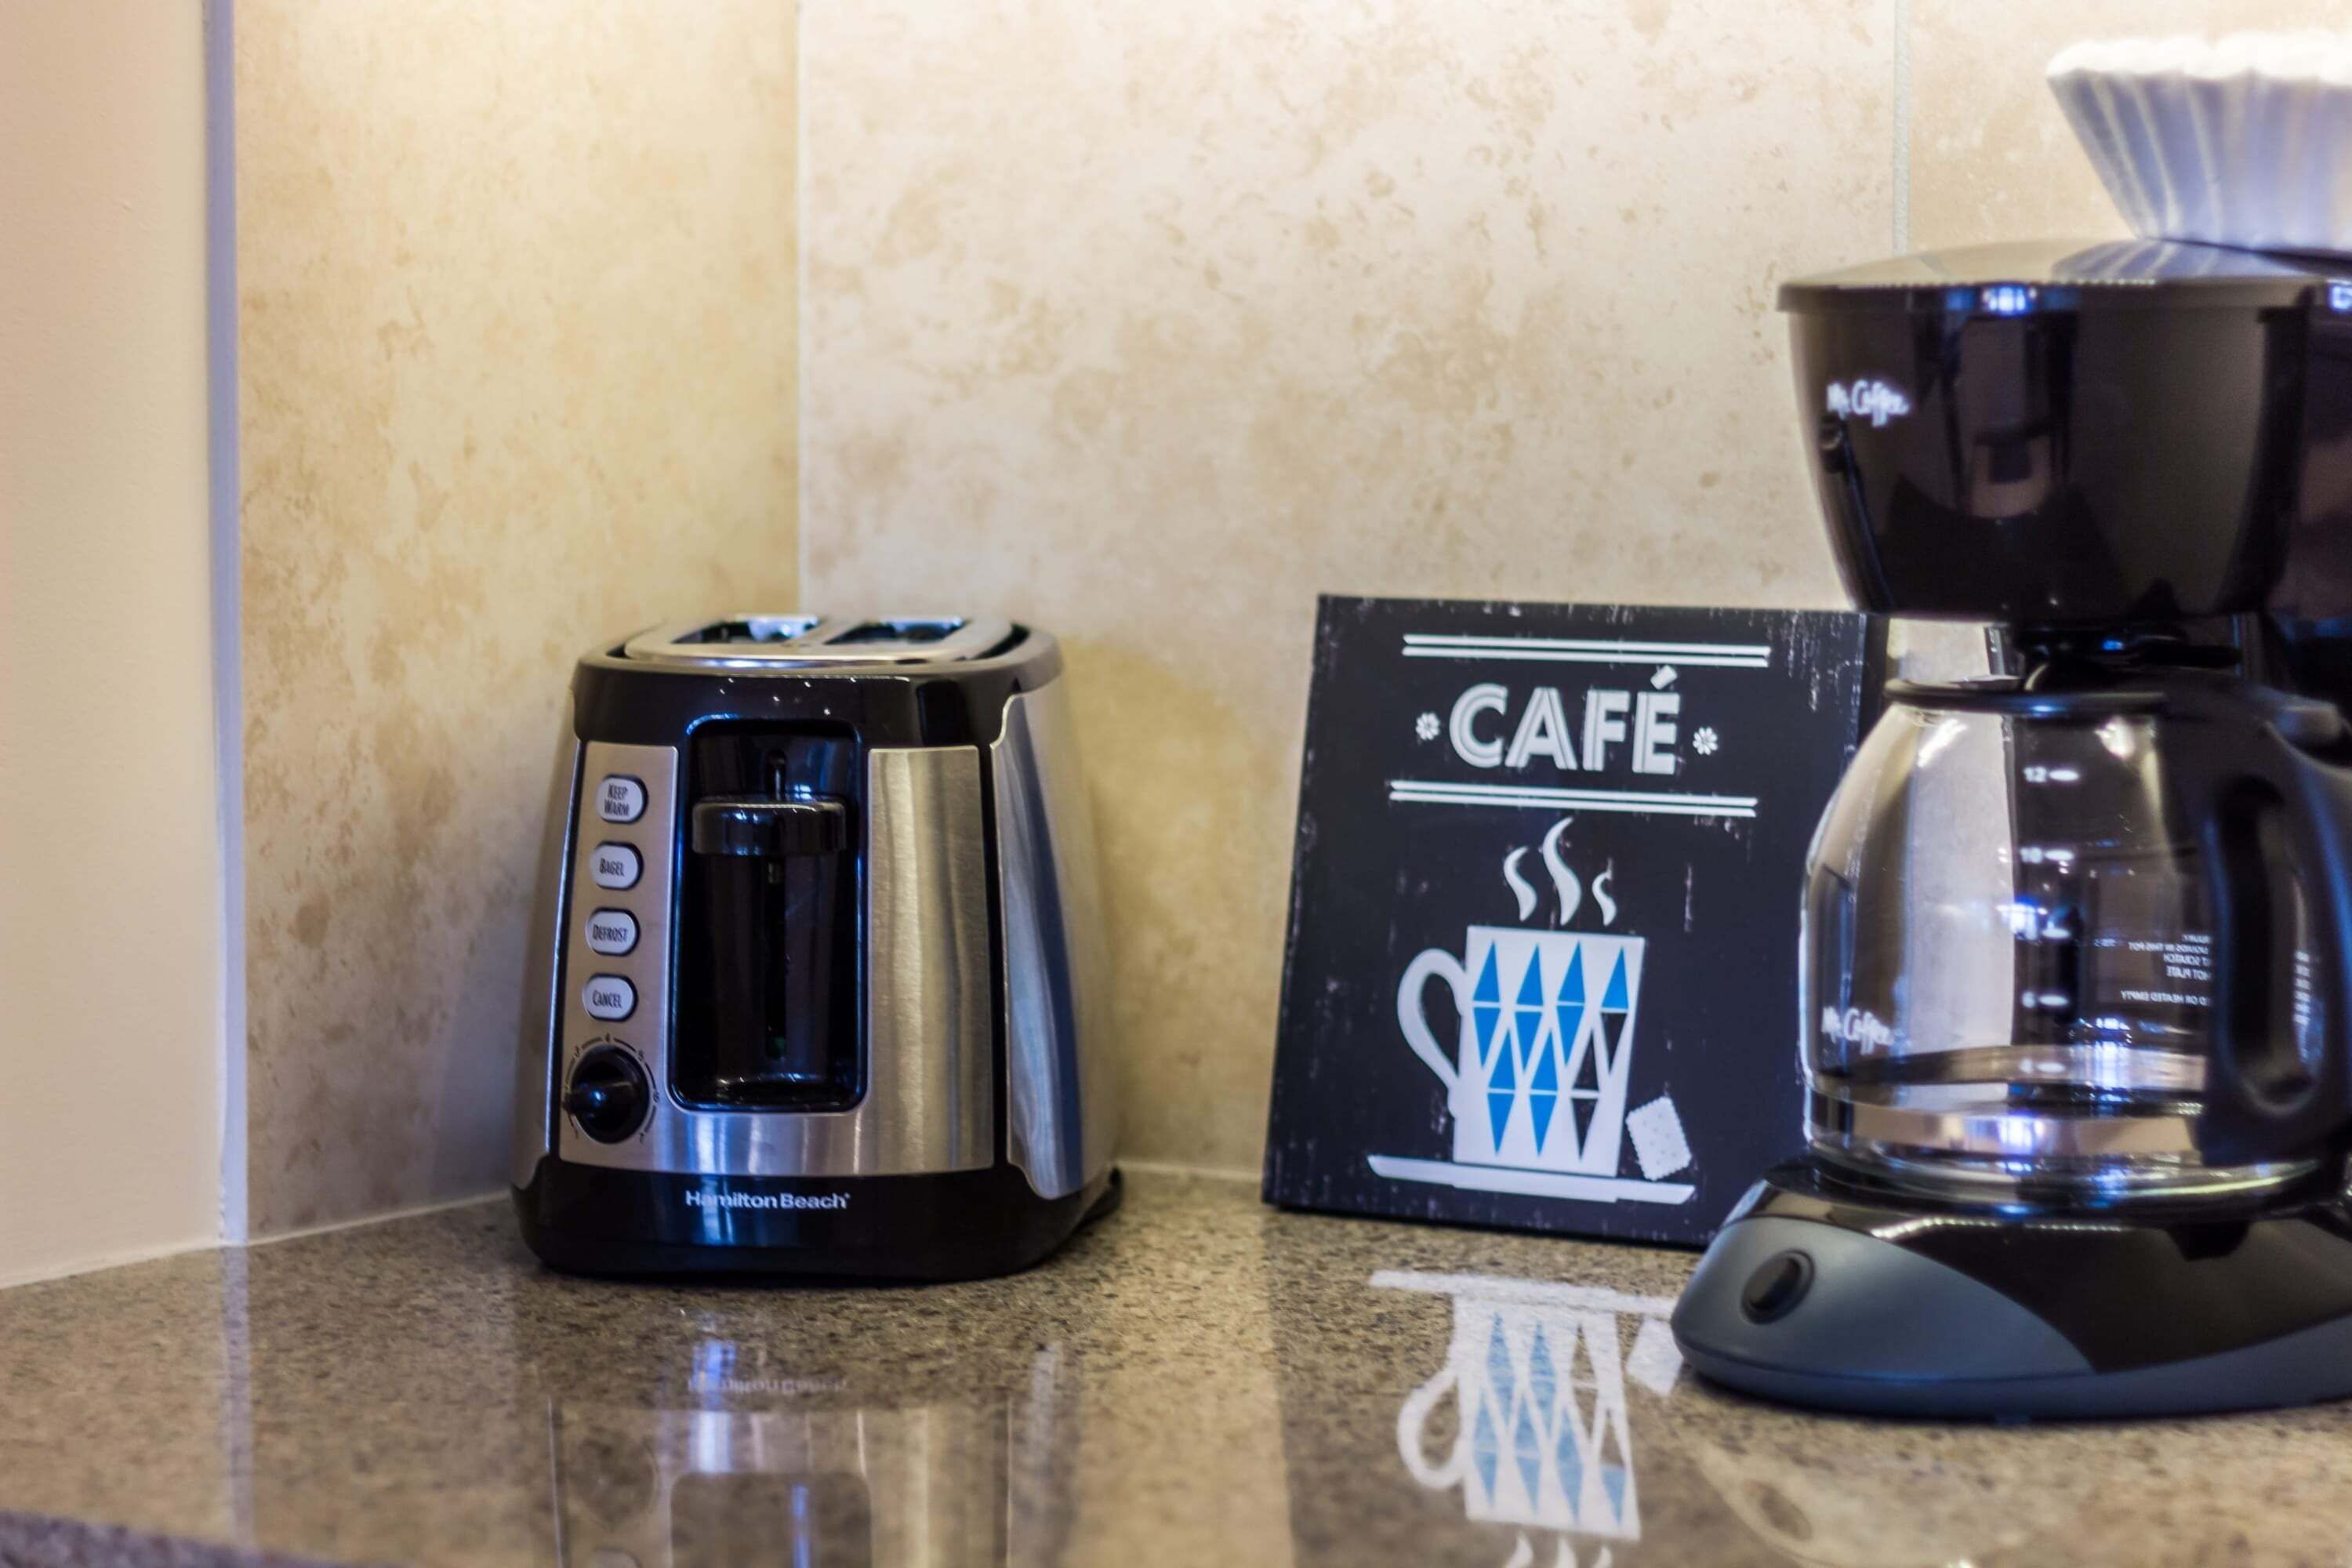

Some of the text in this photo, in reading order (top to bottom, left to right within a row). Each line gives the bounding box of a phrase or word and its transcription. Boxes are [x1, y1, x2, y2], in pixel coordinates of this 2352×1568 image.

[1449, 665, 1681, 775] CAFÉ
[608, 783, 628, 800] KEEP
[604, 799, 630, 816] WARM
[599, 858, 625, 877] BAGEL
[593, 924, 628, 942] DEFROST
[592, 989, 622, 1009] CANCEL
[685, 1189, 848, 1210] Hamilton Beach
